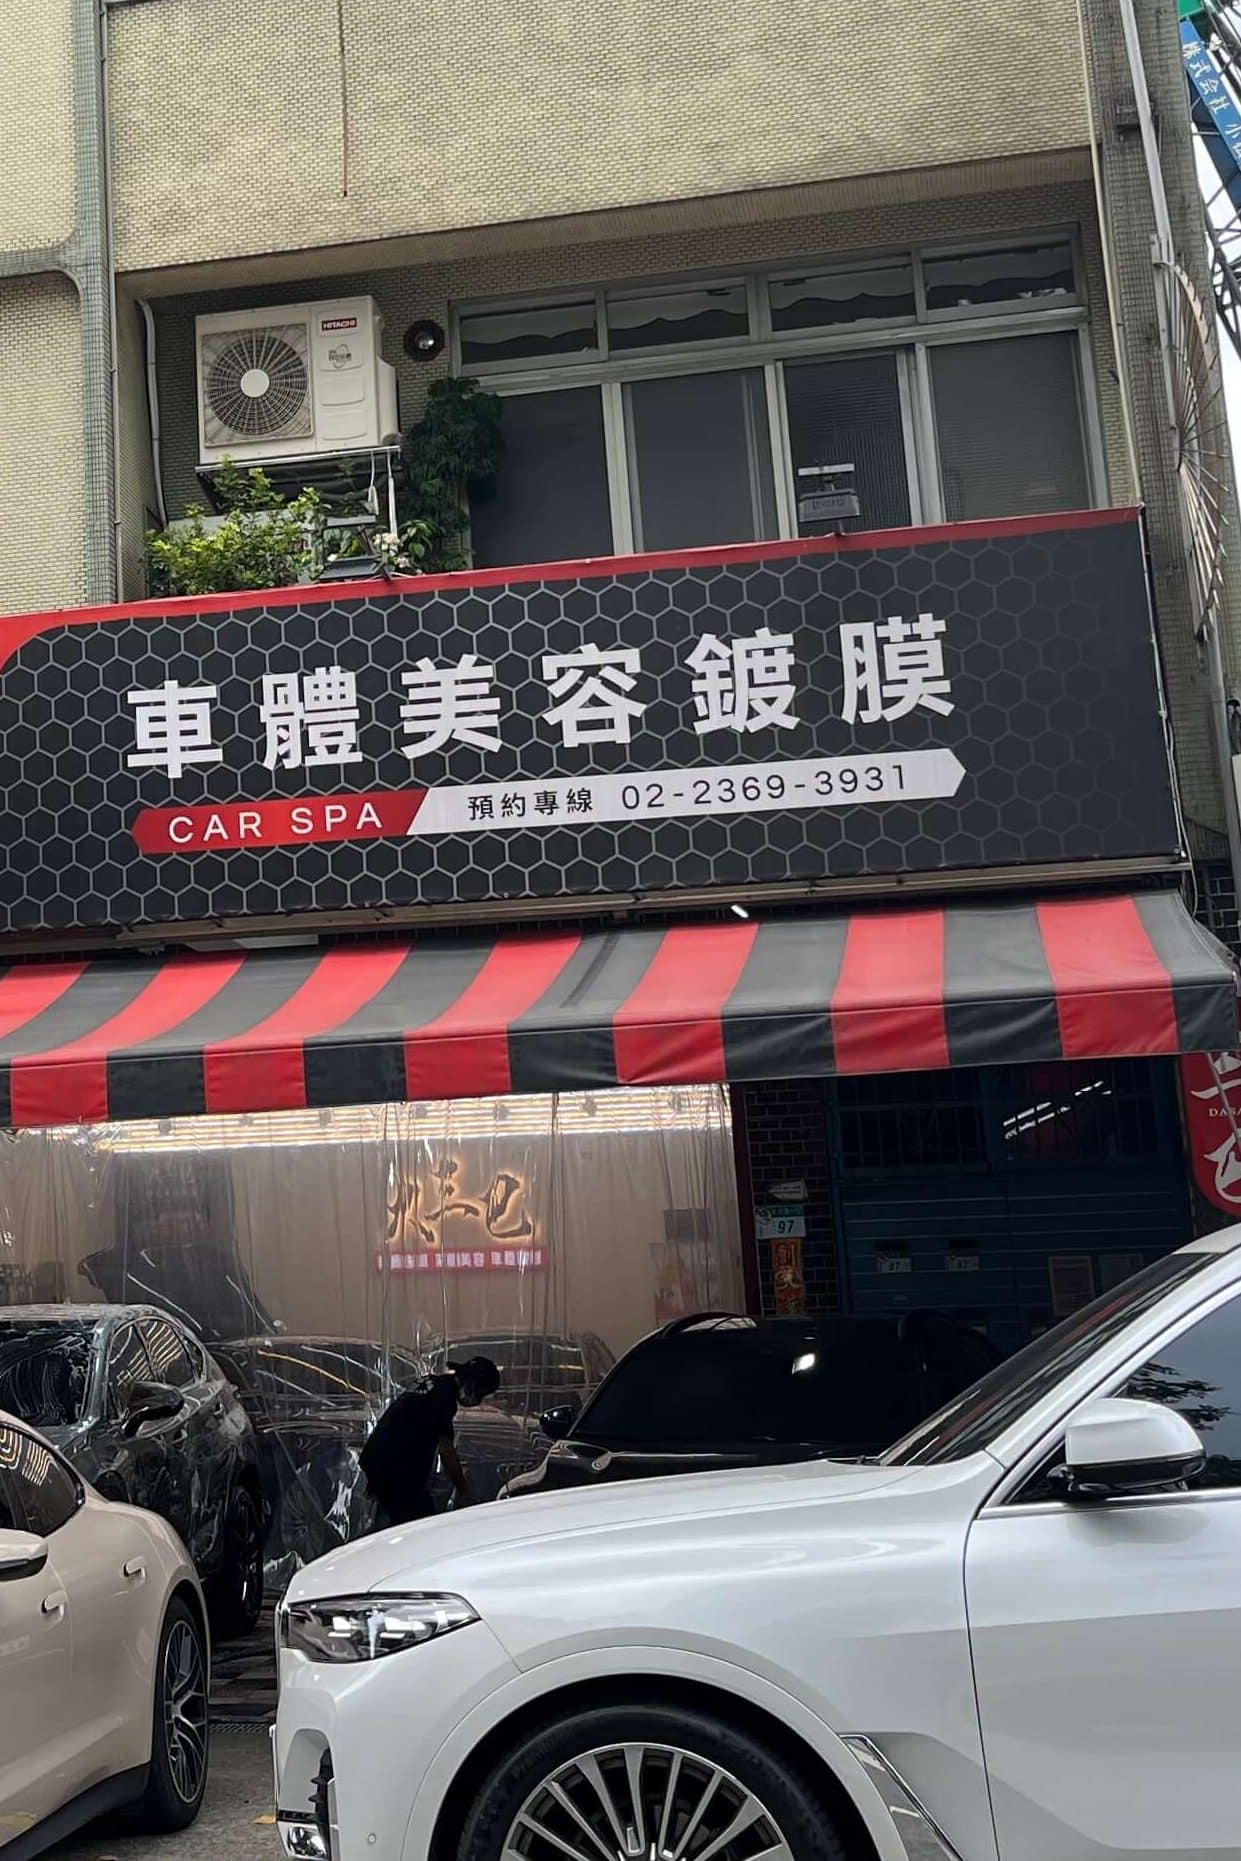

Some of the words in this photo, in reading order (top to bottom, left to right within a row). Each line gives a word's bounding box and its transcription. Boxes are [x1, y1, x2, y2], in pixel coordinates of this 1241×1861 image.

[323, 319, 356, 329] HITACHI
[127, 613, 955, 779] 車體美容鍍膜
[467, 787, 593, 821] 預約專線
[622, 764, 906, 811] 02-2369-3931
[168, 811, 261, 843] CAR
[290, 801, 383, 834] SPA
[778, 1220, 795, 1234] 97
